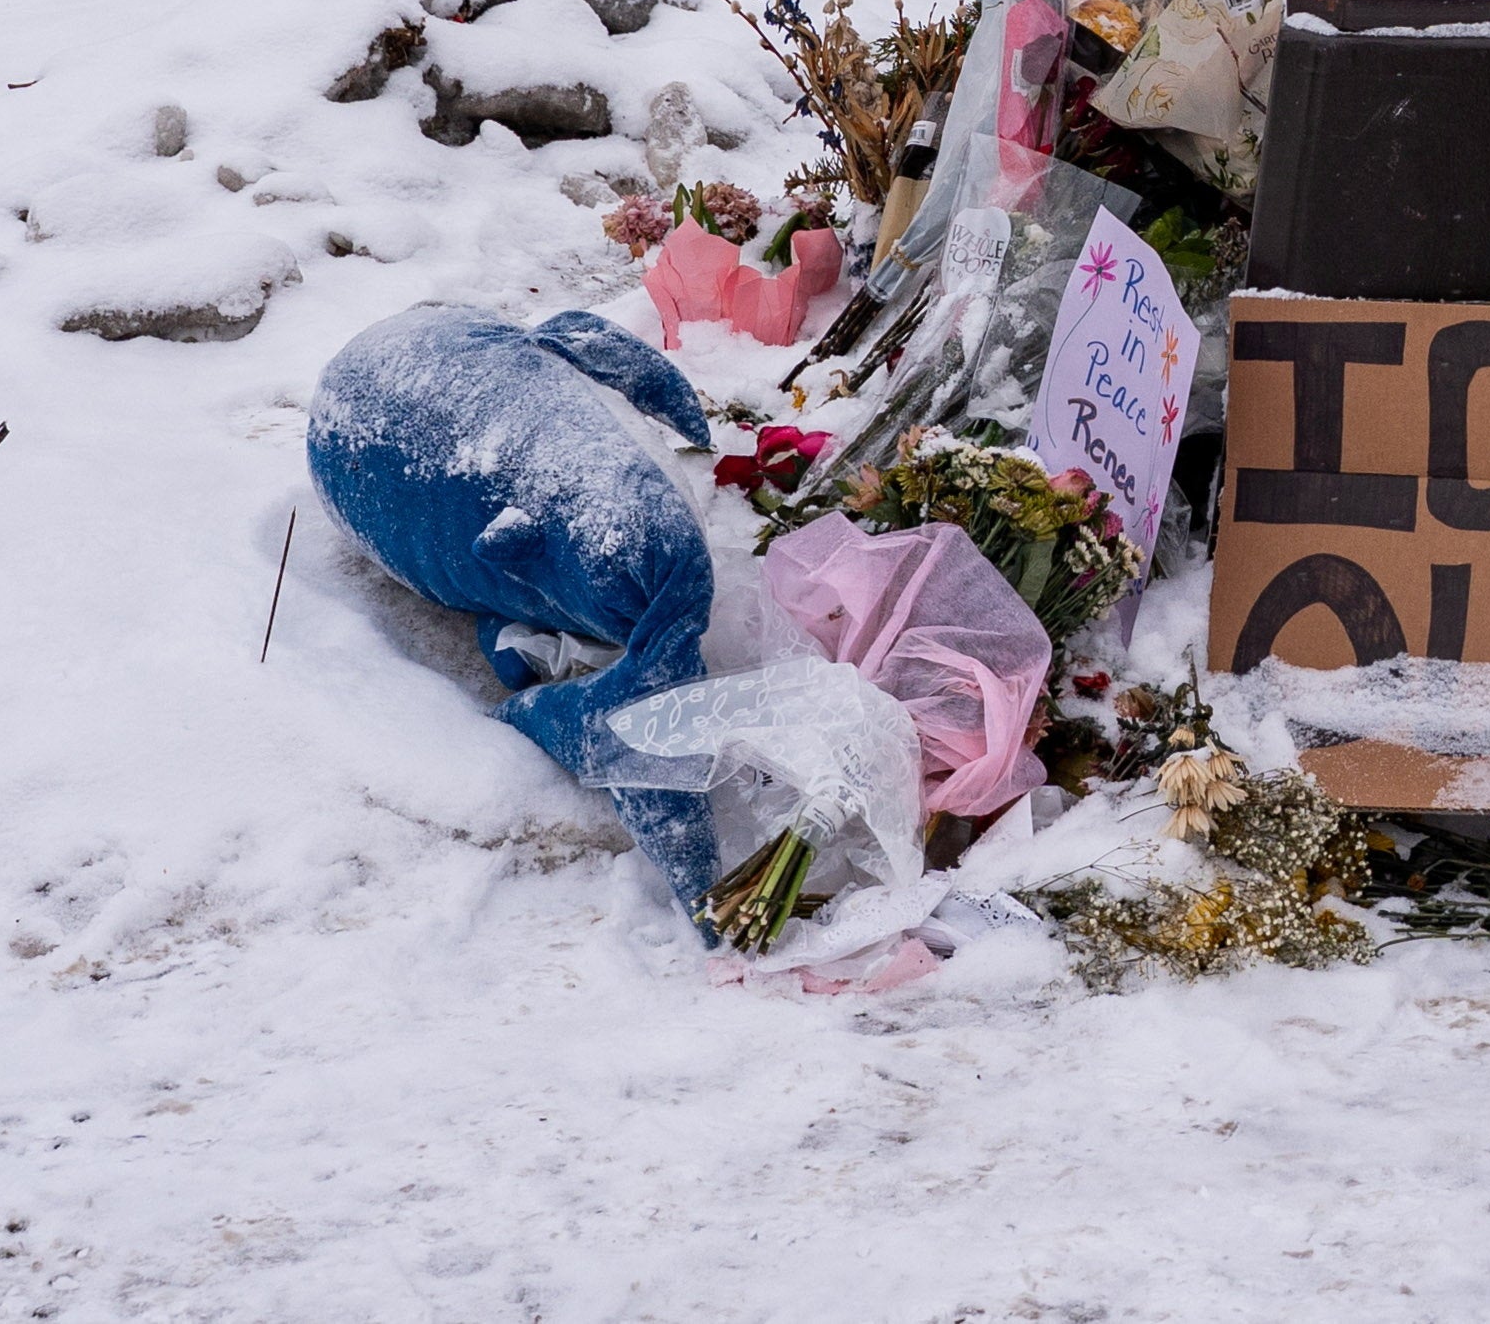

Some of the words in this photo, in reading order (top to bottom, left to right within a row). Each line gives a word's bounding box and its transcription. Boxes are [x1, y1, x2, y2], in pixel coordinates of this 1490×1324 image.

[951, 224, 1004, 259] WHOLE
[1122, 258, 1164, 343] Rest
[1085, 341, 1148, 435] Peace
[1121, 320, 1146, 373] in
[1068, 398, 1136, 506] Renee
